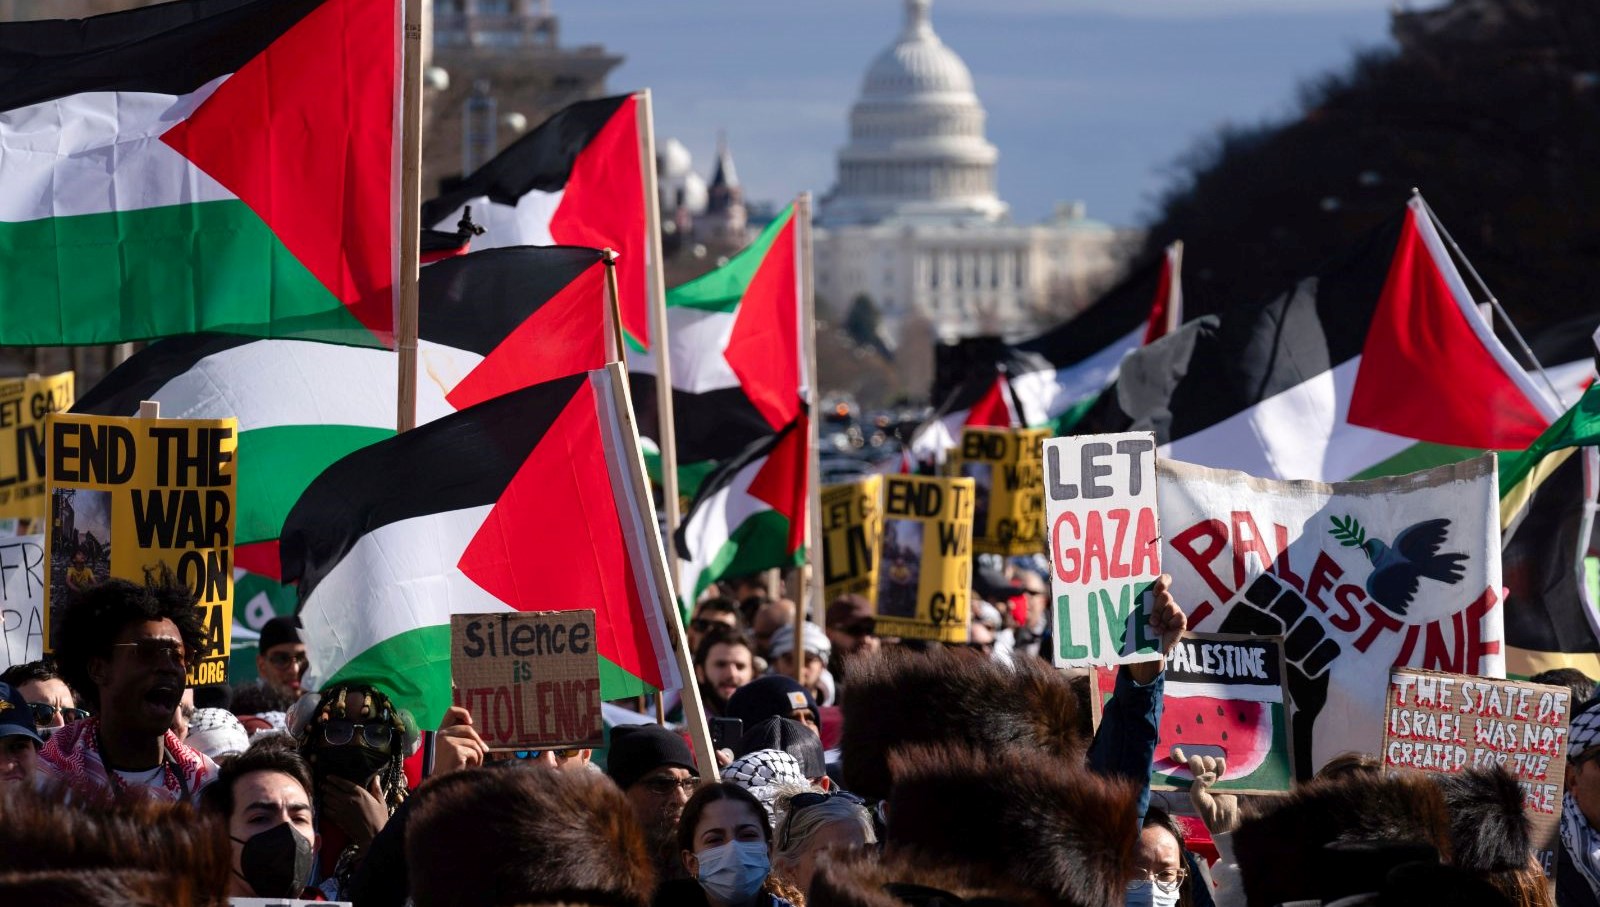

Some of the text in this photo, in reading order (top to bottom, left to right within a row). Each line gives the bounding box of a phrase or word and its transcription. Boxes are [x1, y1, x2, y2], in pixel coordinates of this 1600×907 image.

[0, 399, 23, 428] ET
[52, 423, 232, 487] END THE
[1047, 440, 1153, 500] LET
[131, 489, 229, 549] WAR
[887, 480, 942, 517] END
[1053, 507, 1160, 584] GAZA
[177, 551, 227, 602] ON
[1170, 511, 1499, 675] PALESTINE
[463, 616, 590, 658] Silence
[1058, 581, 1160, 659] LIVE
[185, 661, 225, 685] N.ORG
[513, 660, 532, 683] is
[1165, 641, 1268, 679] PALESTINE
[1391, 675, 1568, 726] THE STATE OF
[1389, 708, 1567, 757] ISRAEL WAS NOT
[1386, 741, 1467, 773] CREATED
[1513, 753, 1550, 780] THE
